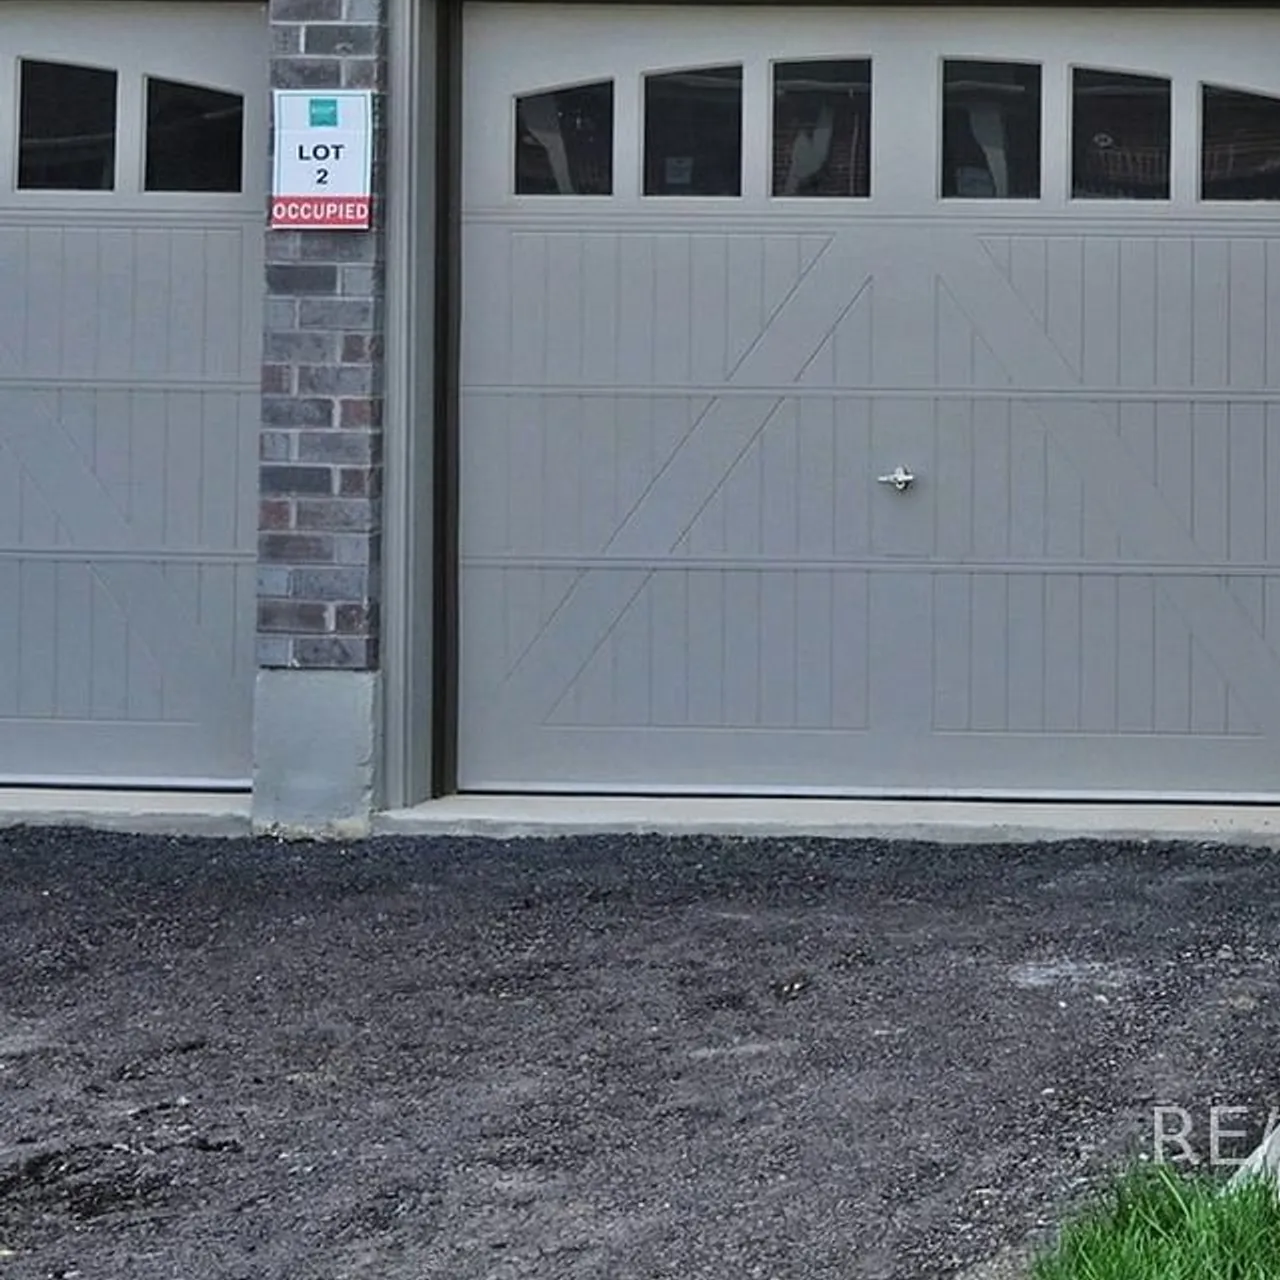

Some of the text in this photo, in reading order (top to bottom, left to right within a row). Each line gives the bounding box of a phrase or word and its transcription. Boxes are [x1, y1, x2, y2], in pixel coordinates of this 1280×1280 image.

[298, 145, 345, 161] LOT
[315, 168, 329, 185] 2
[272, 203, 369, 219] OCCUPIED
